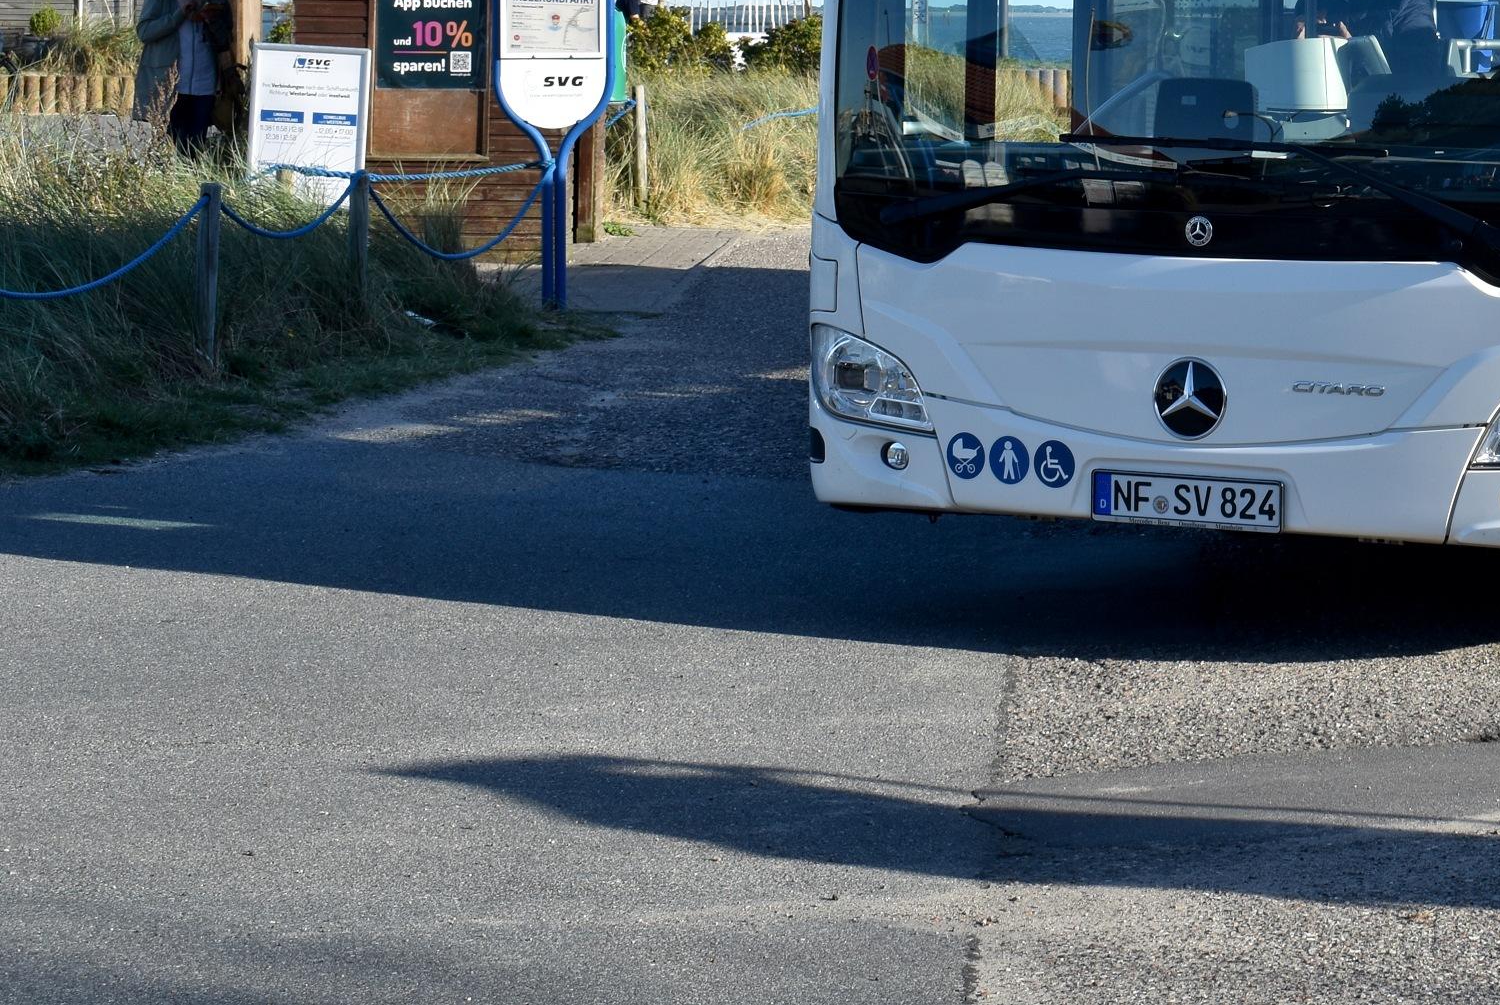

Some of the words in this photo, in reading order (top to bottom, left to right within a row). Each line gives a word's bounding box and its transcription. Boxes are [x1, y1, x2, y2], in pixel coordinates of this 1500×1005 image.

[393, 36, 412, 46] und
[307, 58, 331, 66] SVG
[393, 58, 446, 74] sparen!
[544, 76, 584, 87] SVG
[1292, 381, 1385, 397] CITARO
[1100, 499, 1107, 509] D
[1113, 480, 1152, 512] NF
[1173, 484, 1212, 517] SV
[1220, 487, 1276, 521] 824
